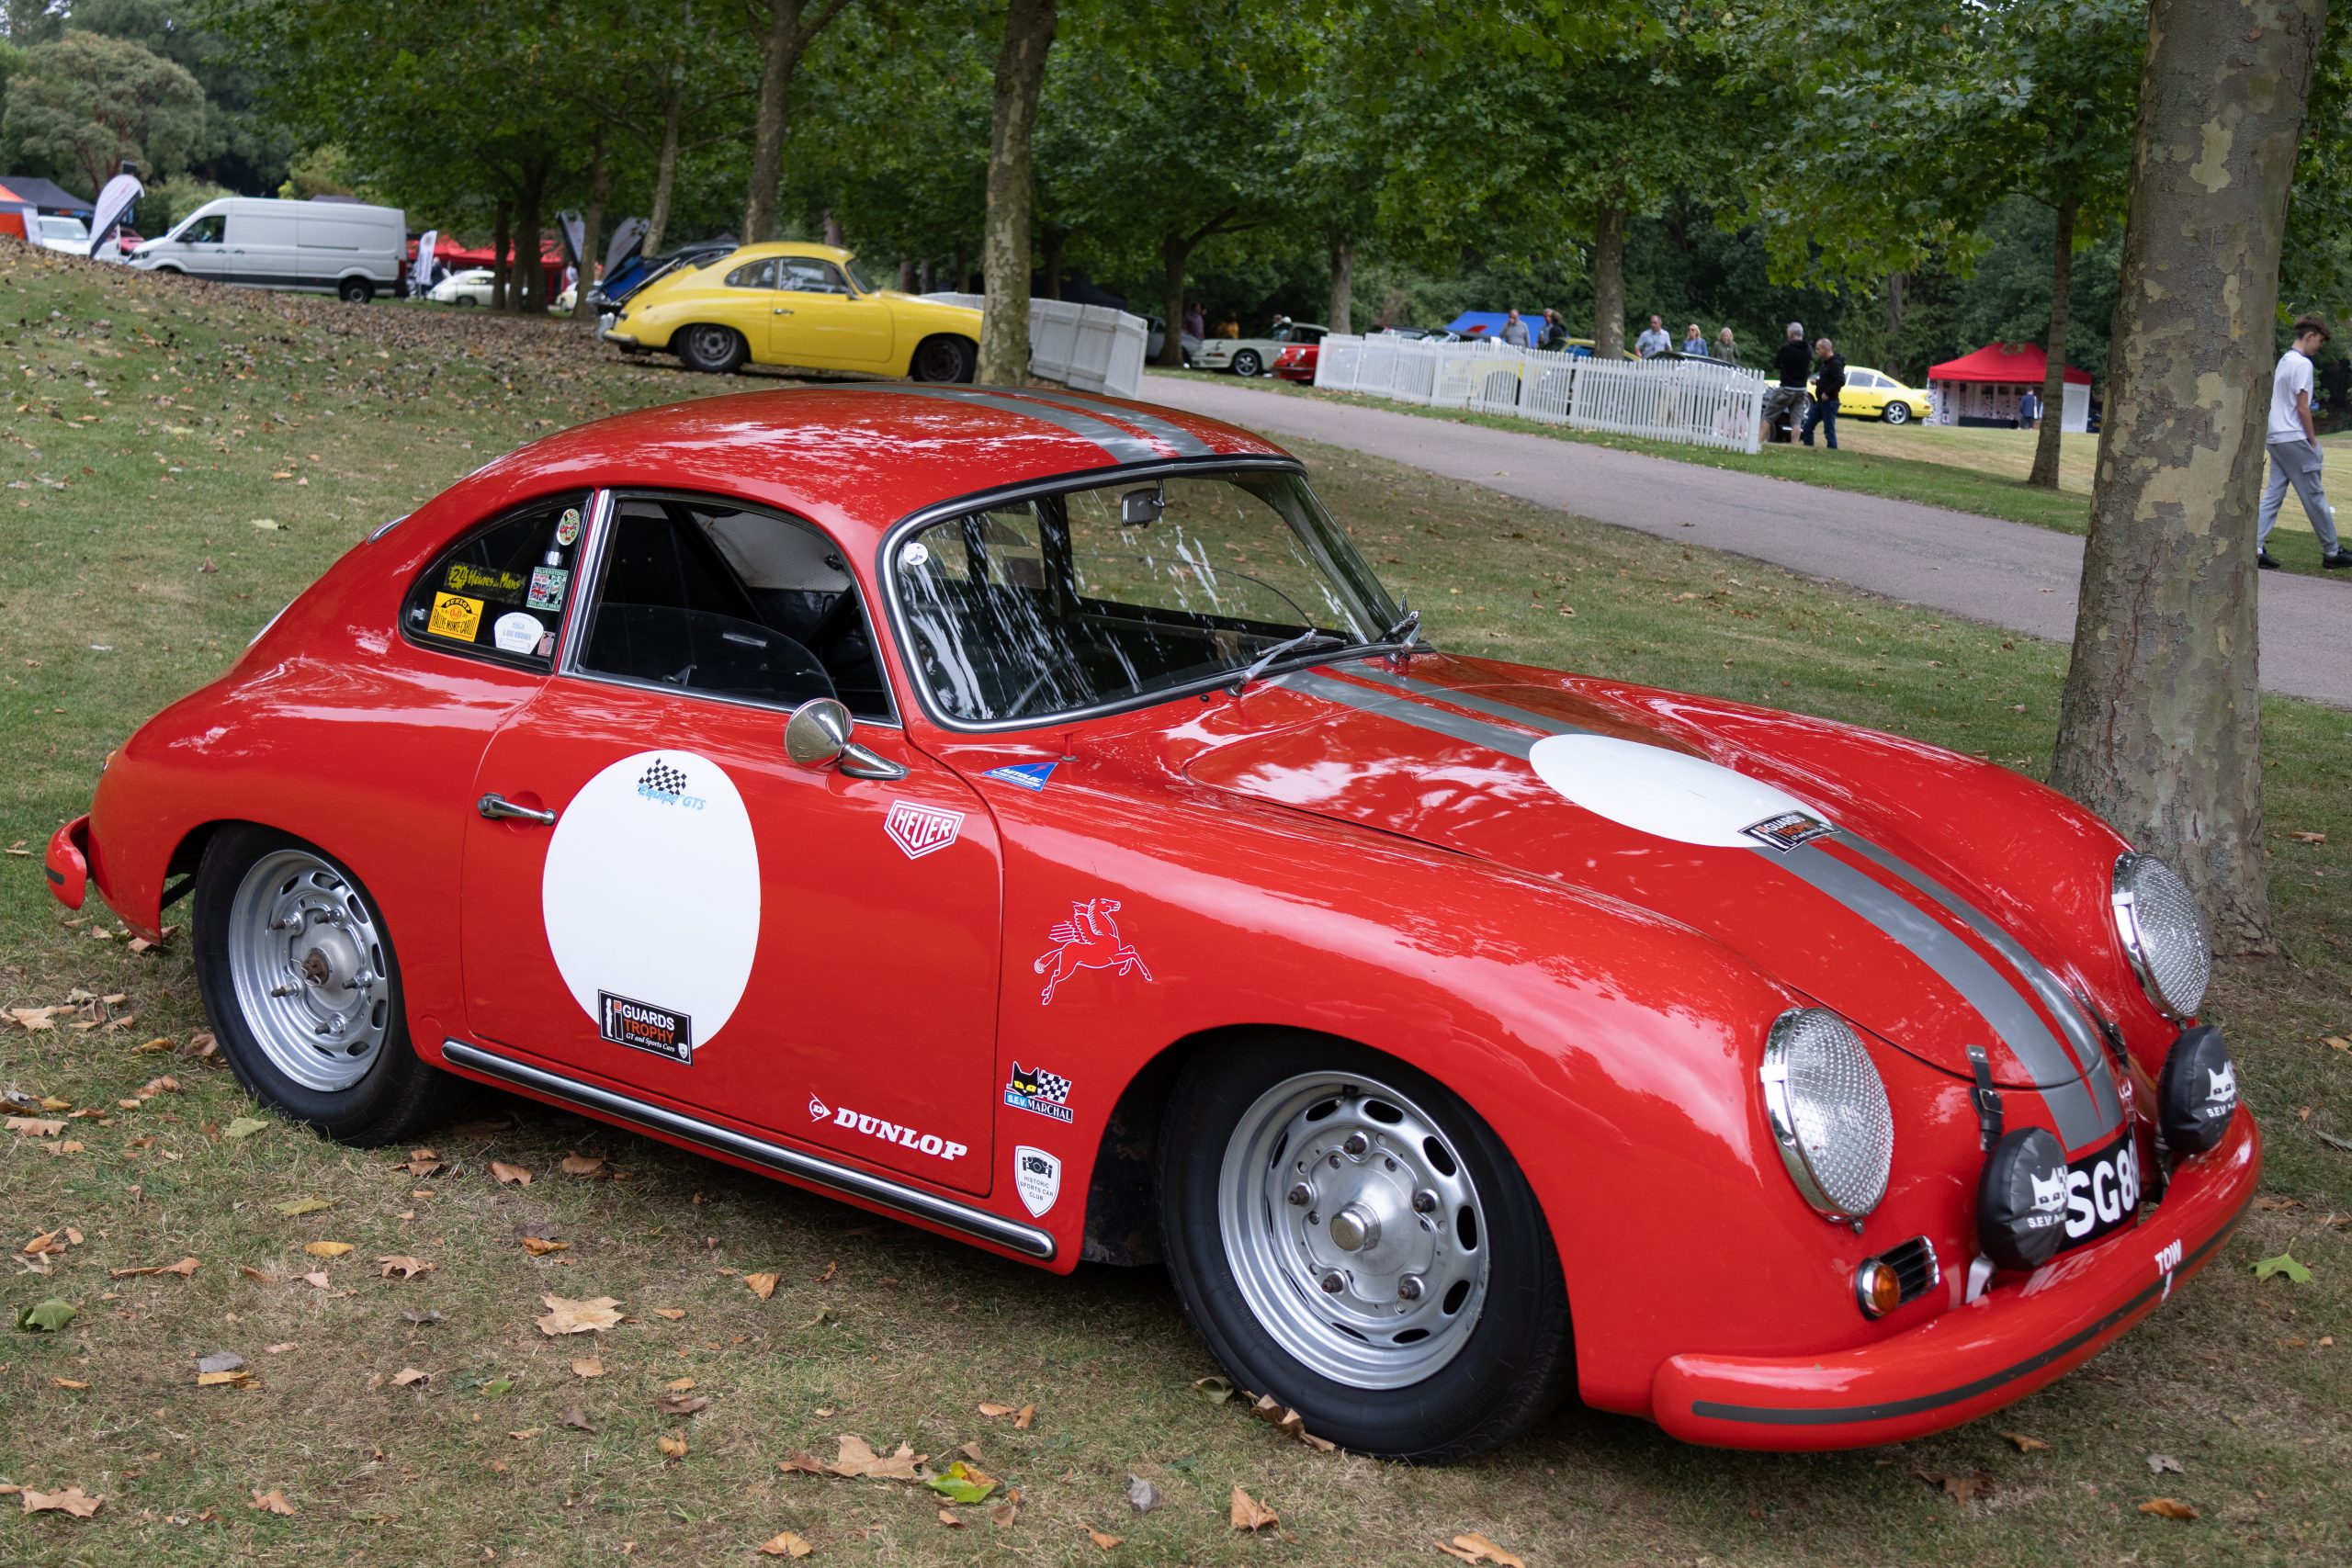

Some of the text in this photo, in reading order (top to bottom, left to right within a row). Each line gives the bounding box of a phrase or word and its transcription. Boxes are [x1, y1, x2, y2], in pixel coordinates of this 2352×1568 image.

[450, 569, 465, 583] 24
[446, 598, 470, 611] DUNLOP
[638, 784, 707, 810] Equipe GTS
[894, 809, 954, 848] HEUER
[622, 1004, 675, 1031] GUARDS
[624, 1018, 674, 1044] TROPHY
[626, 1032, 675, 1053] GT and Sports Cars
[1027, 1099, 1071, 1121] MARCHAL
[833, 1107, 968, 1161] DUNLOP
[1020, 1181, 1054, 1197] SPORTS CAR
[1023, 1176, 1049, 1189] HISTORIC
[1029, 1191, 1044, 1201] CLUB
[2154, 1238, 2182, 1275] TOW
